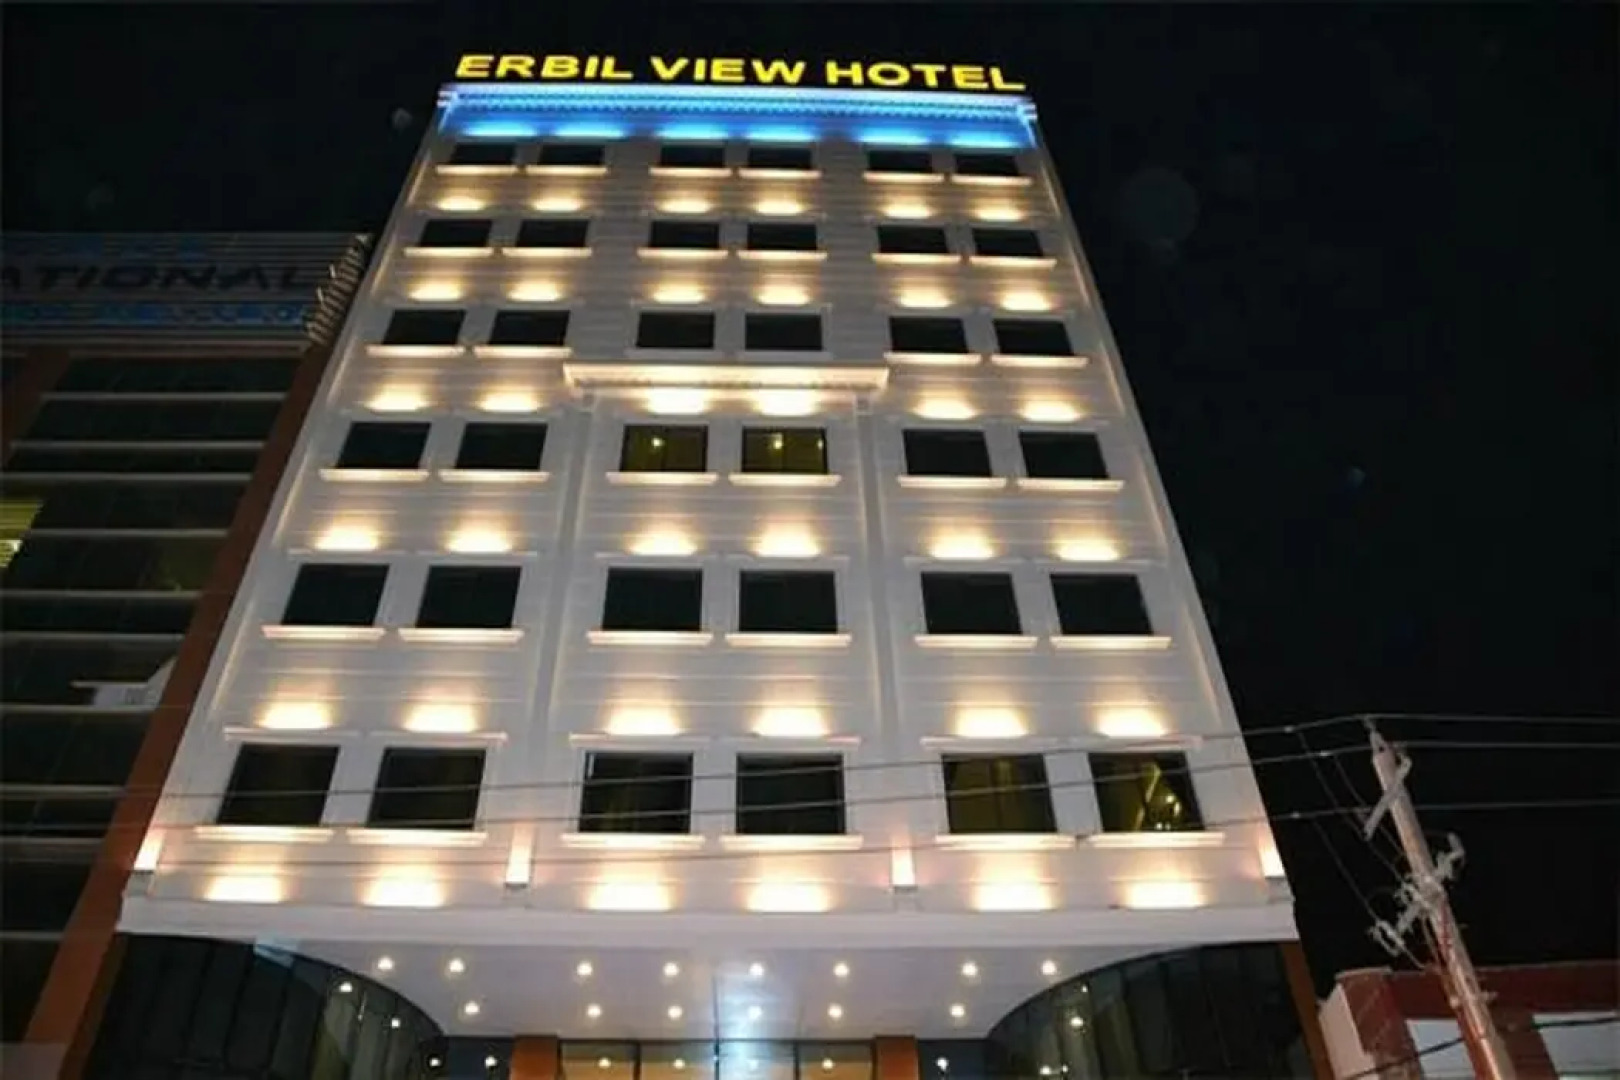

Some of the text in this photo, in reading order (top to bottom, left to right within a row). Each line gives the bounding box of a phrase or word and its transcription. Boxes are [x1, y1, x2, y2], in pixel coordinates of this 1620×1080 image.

[456, 55, 1025, 91] ERBIL VIEW HOTEL
